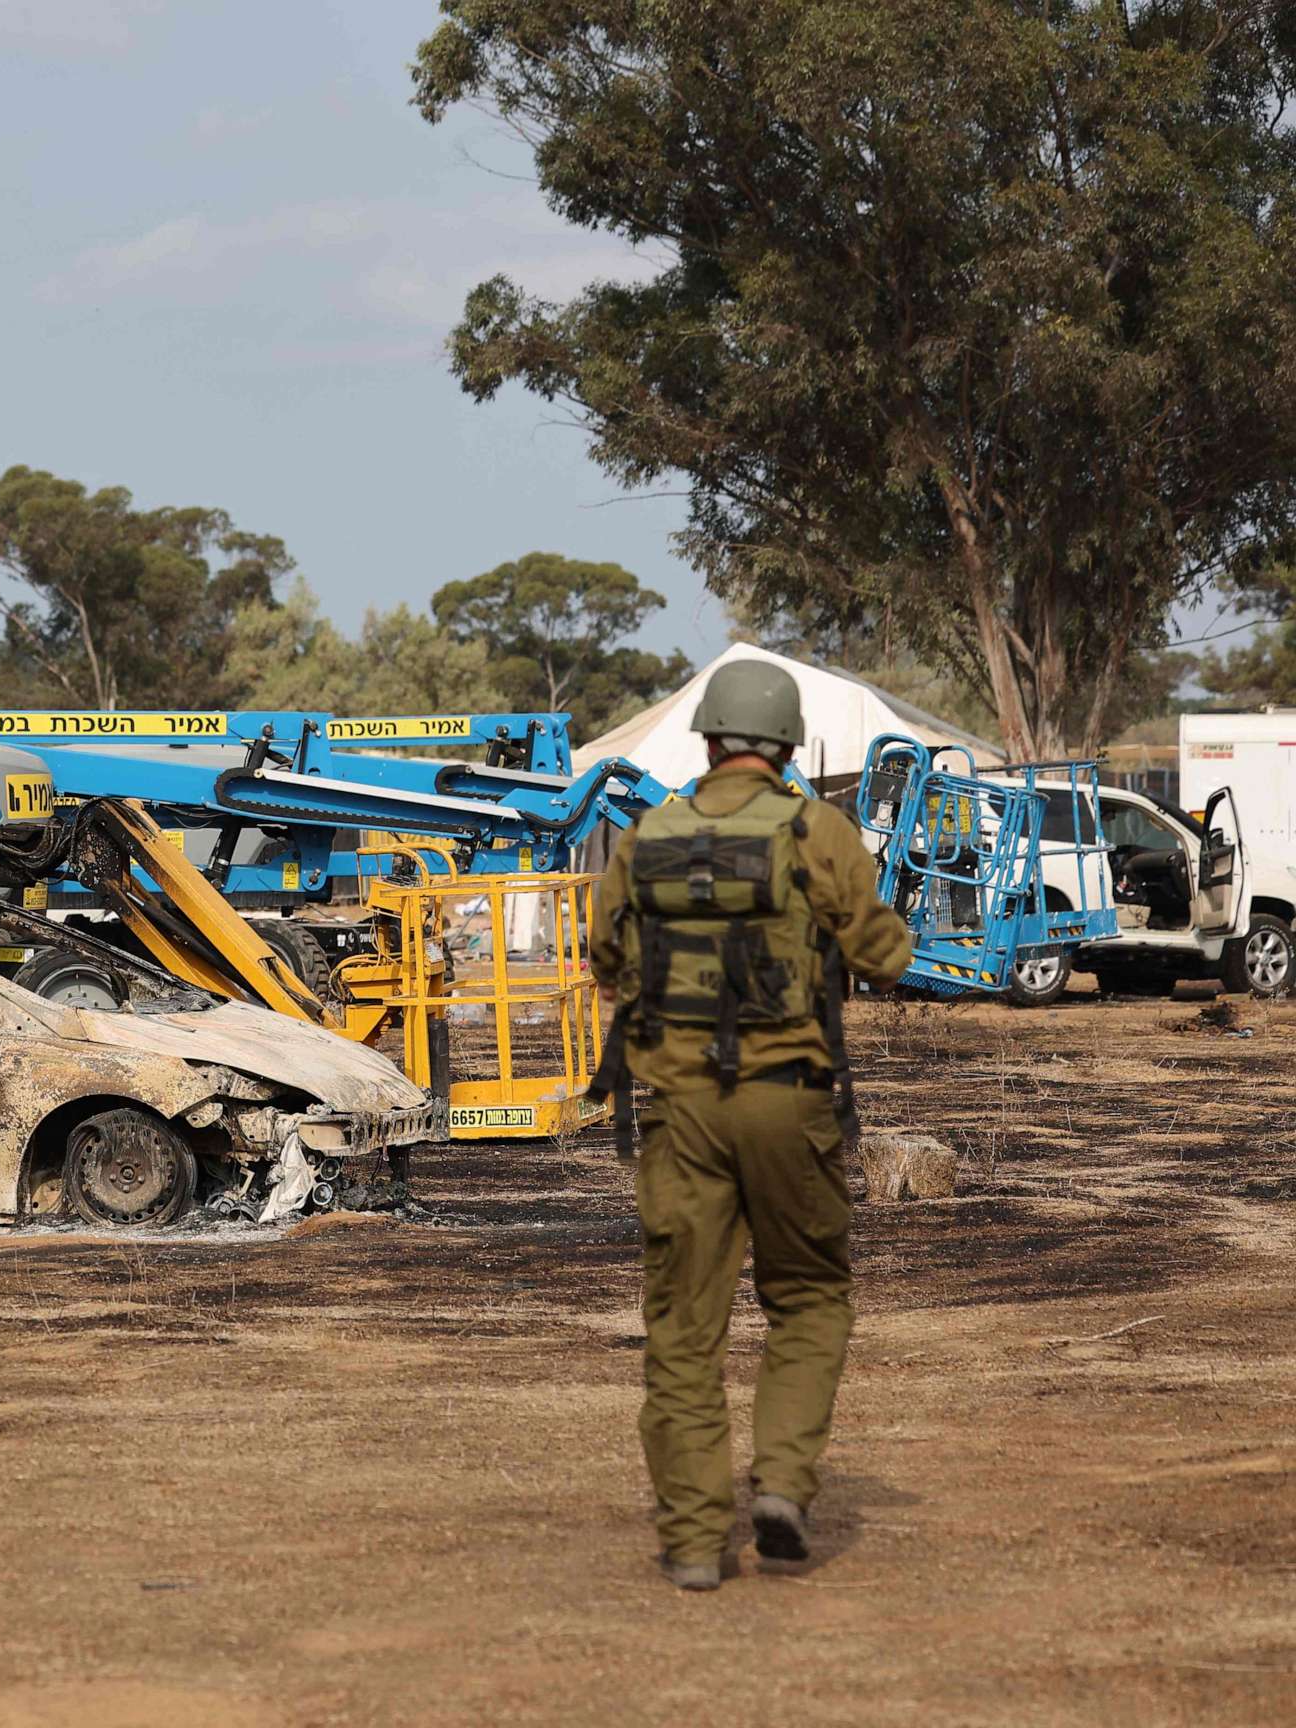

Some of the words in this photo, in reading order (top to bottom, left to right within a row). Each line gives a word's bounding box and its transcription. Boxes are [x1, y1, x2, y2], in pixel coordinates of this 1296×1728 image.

[50, 716, 136, 733] השכרת
[164, 716, 221, 733] אמיר
[329, 721, 398, 737] השכרת
[419, 719, 465, 735] אמיר
[451, 1109, 484, 1126] 6657
